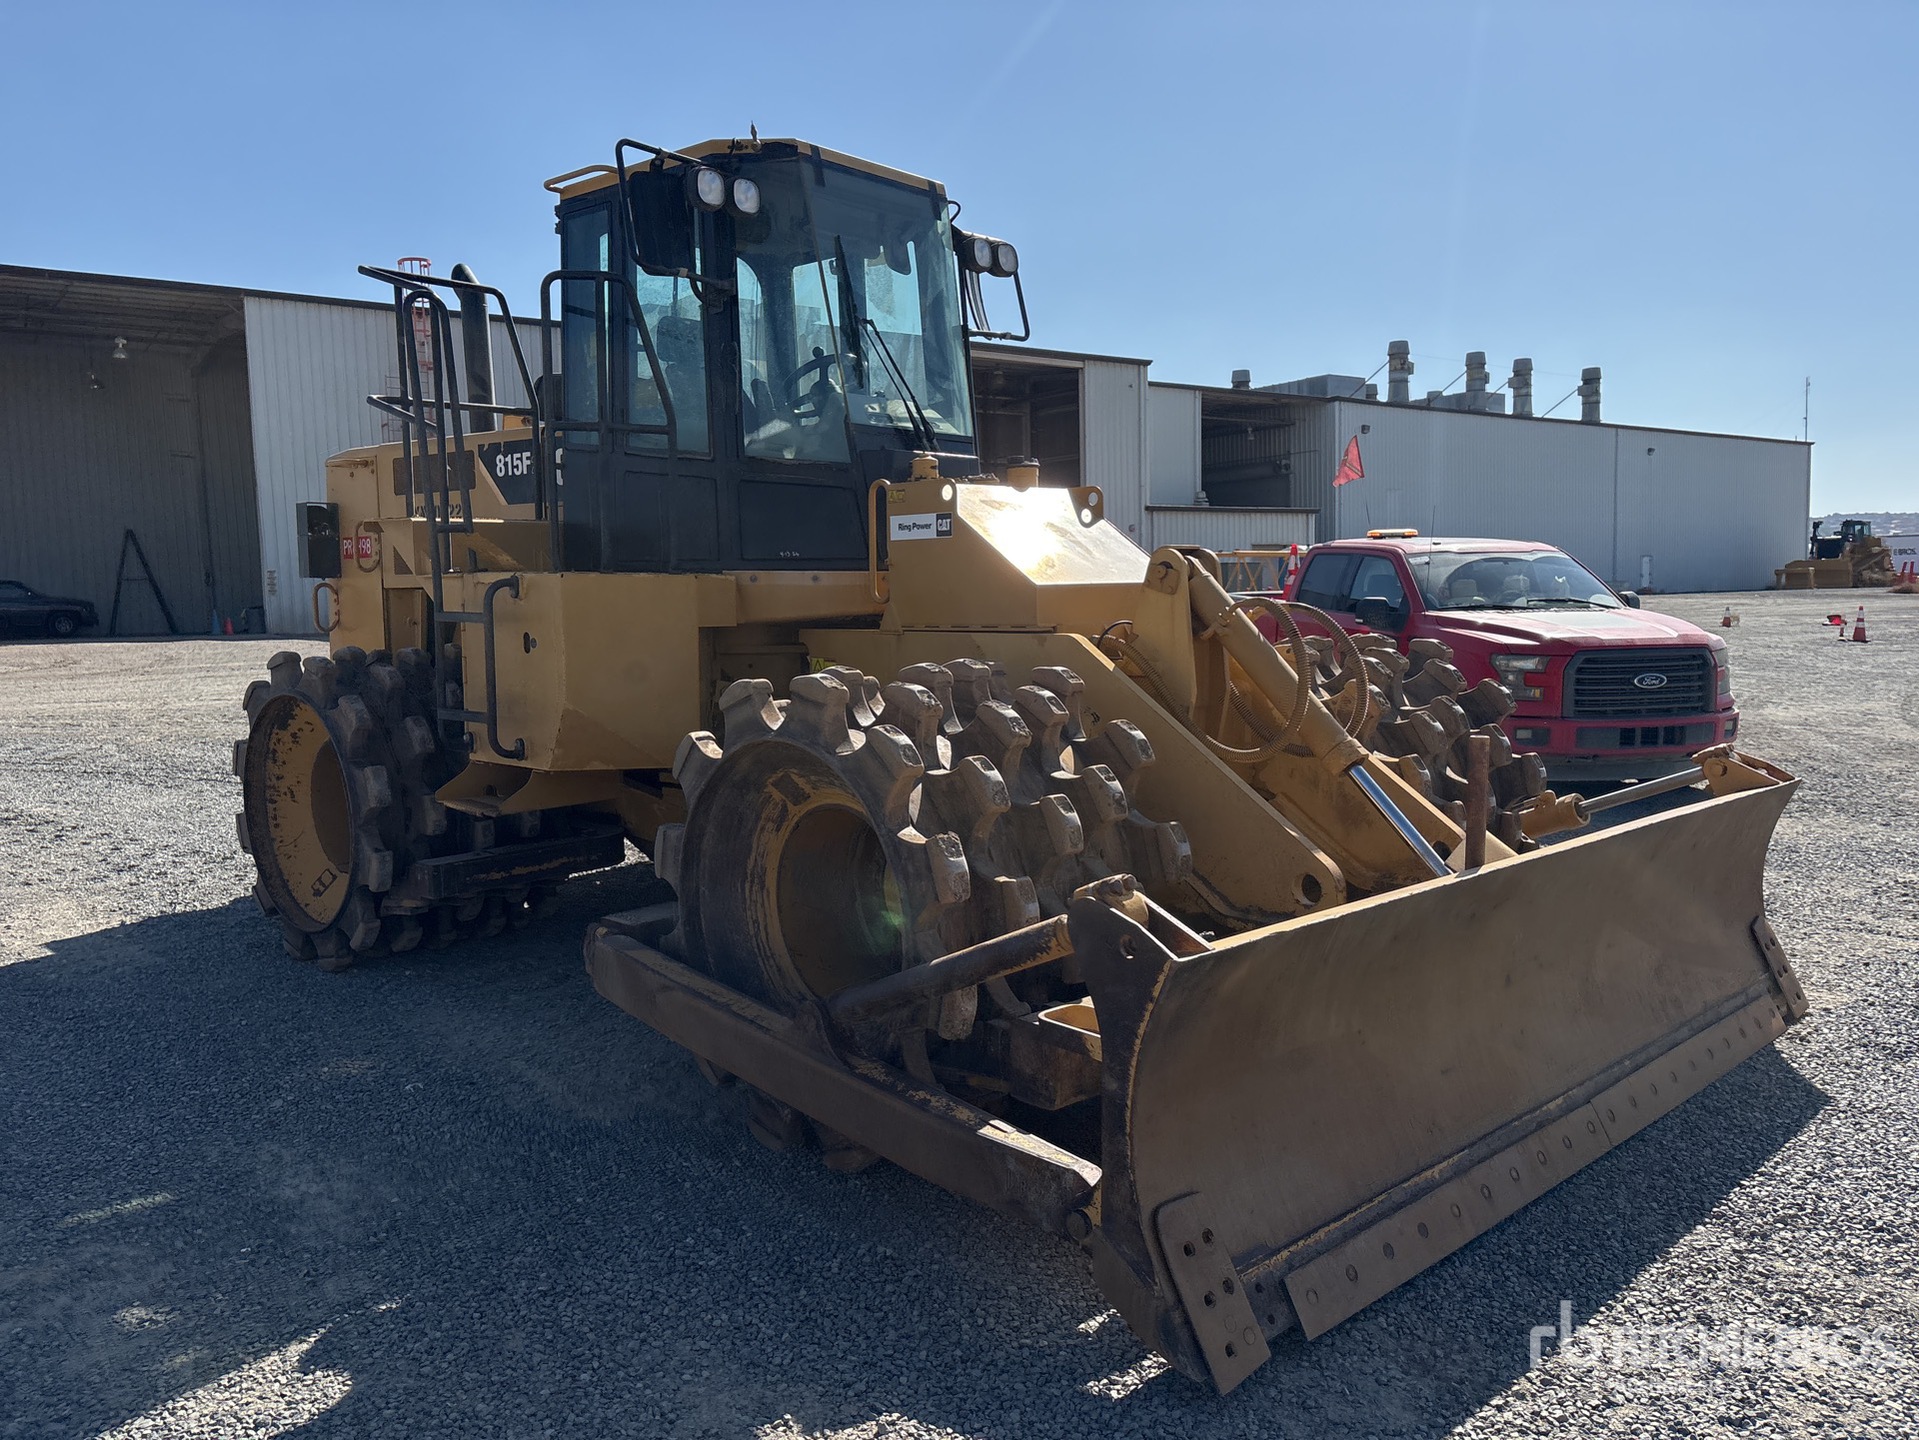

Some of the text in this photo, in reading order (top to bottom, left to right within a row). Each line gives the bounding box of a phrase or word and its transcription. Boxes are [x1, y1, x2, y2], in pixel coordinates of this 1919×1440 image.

[898, 522, 932, 532] Ring Power
[937, 518, 951, 531] CAT
